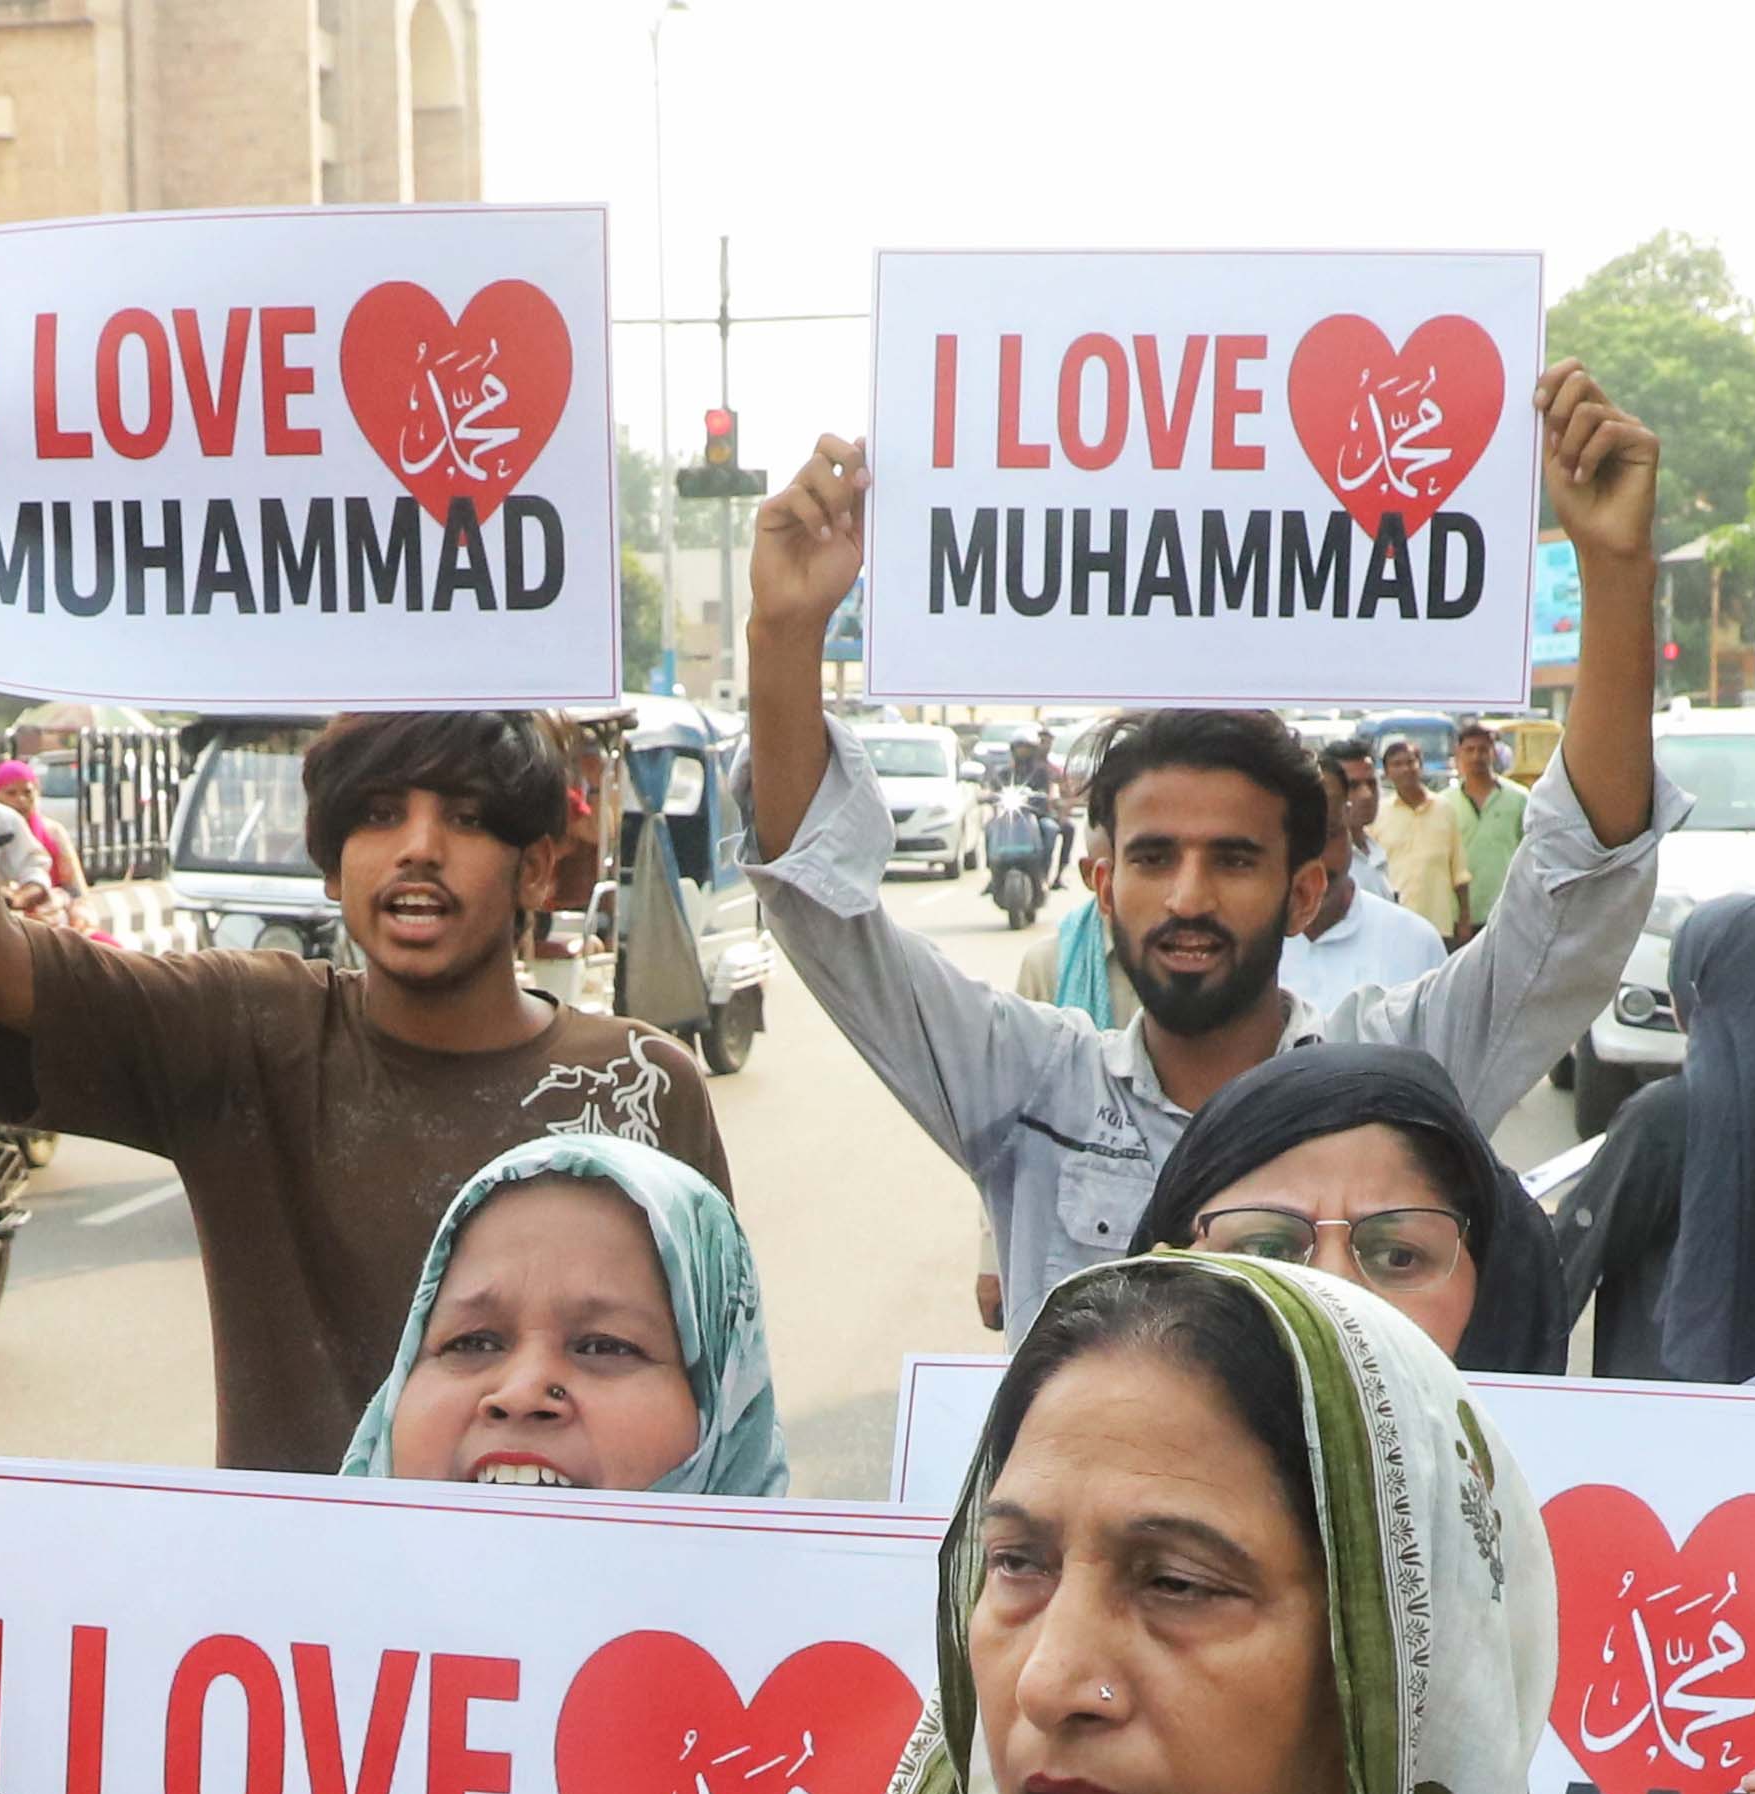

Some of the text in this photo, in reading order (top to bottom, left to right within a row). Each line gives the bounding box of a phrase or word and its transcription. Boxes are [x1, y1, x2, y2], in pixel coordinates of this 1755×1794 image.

[34, 306, 323, 459] LOVE
[932, 333, 1268, 471] I LOVE
[929, 507, 1486, 620] MUHAMMAD
